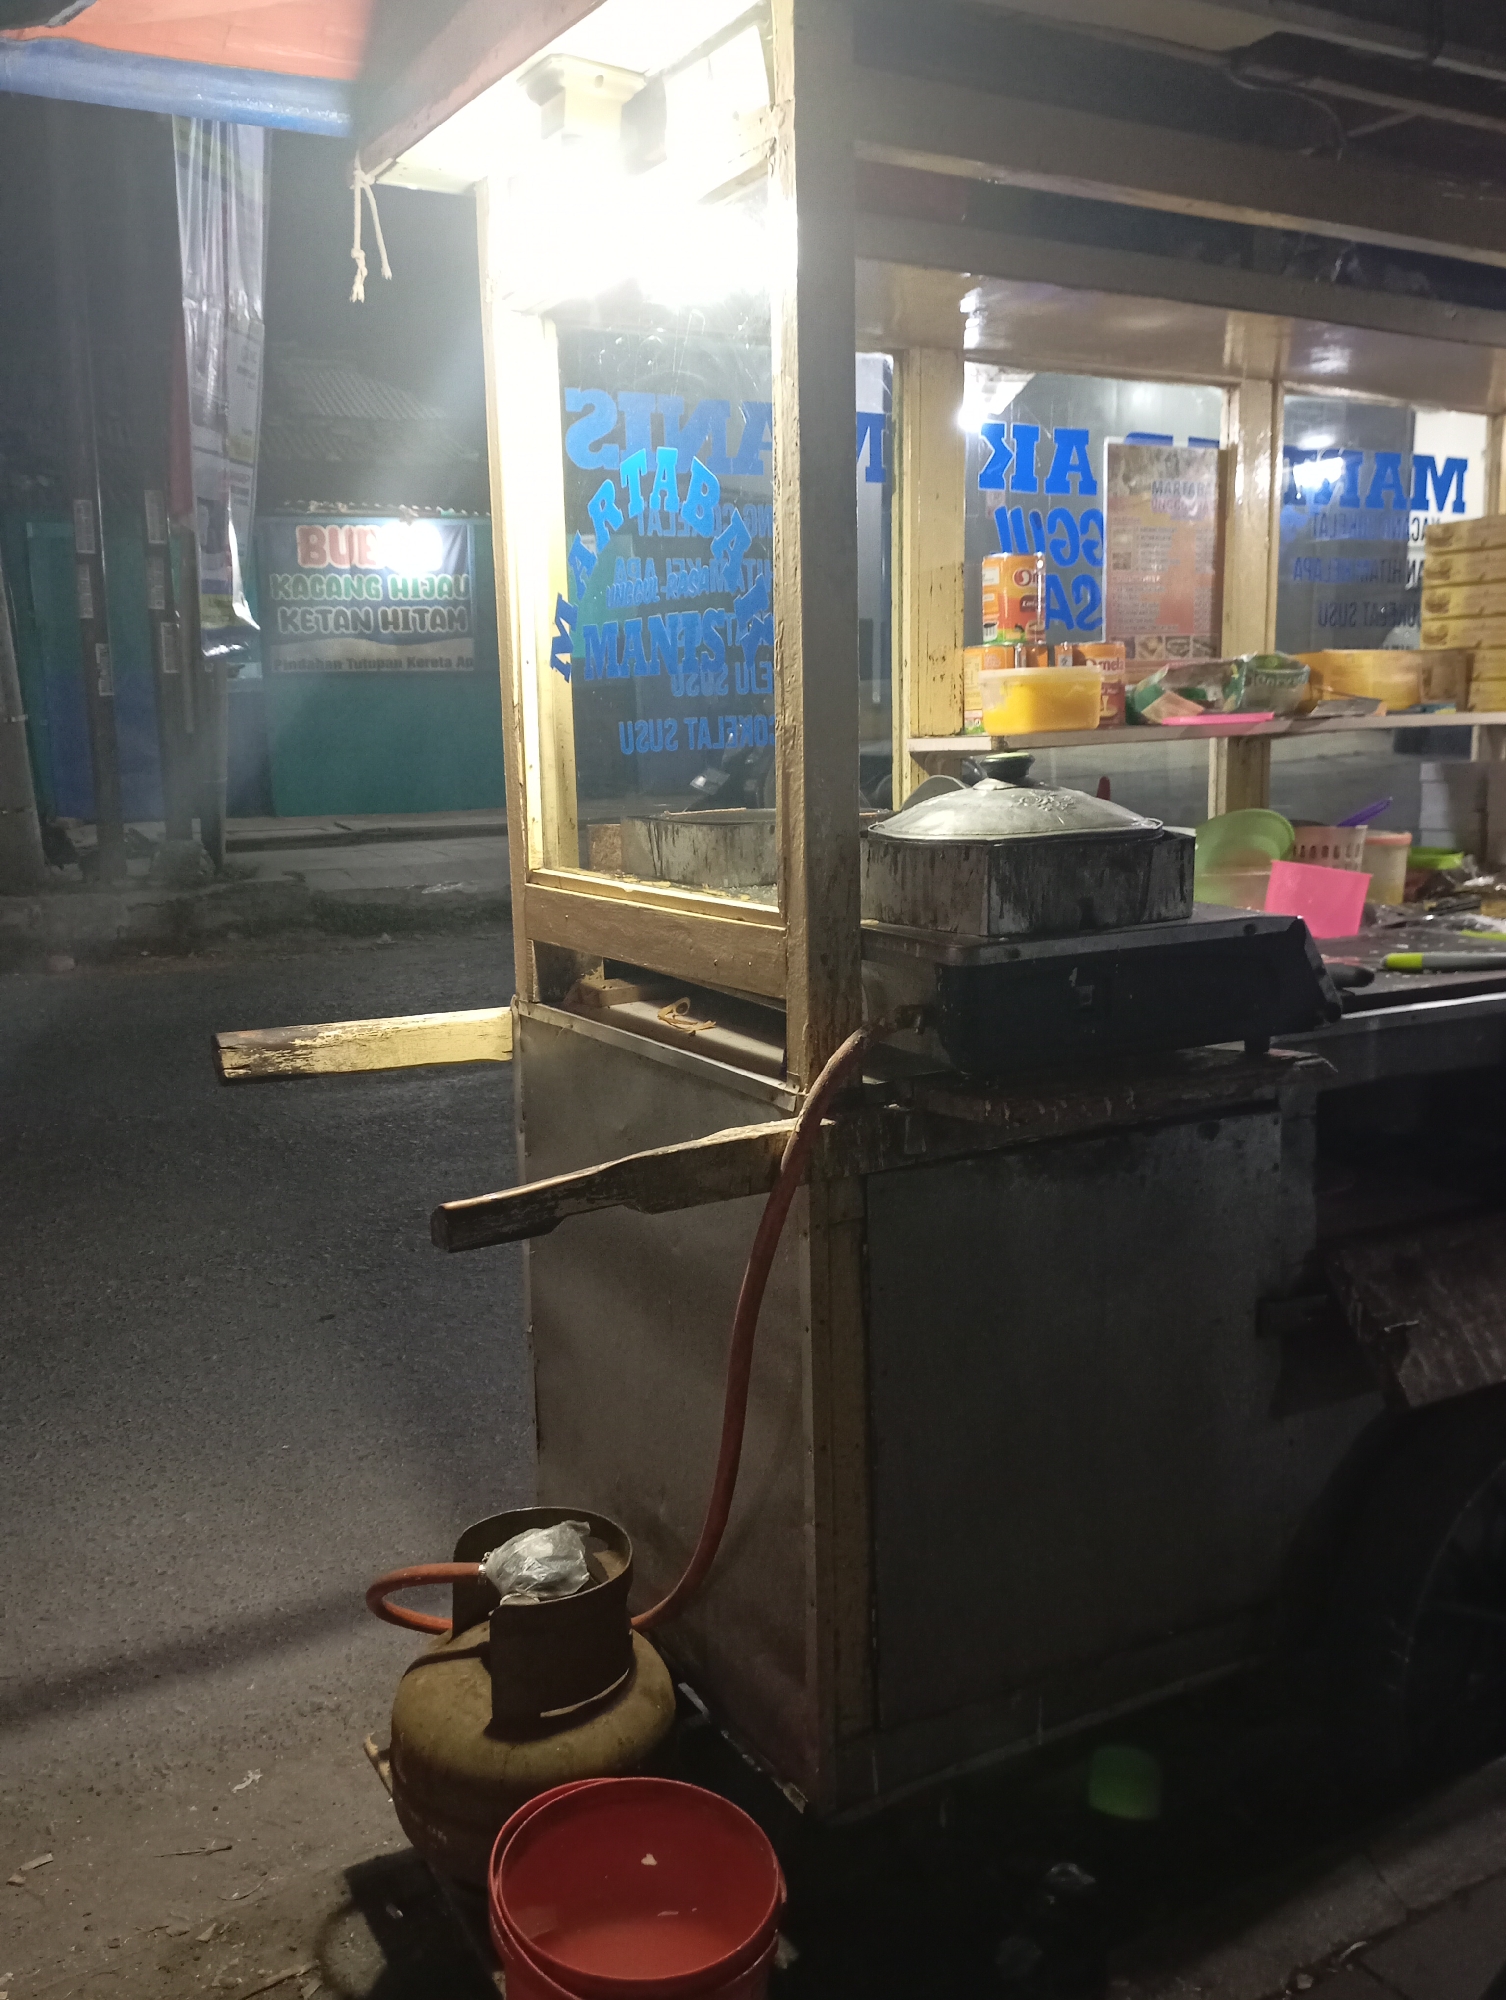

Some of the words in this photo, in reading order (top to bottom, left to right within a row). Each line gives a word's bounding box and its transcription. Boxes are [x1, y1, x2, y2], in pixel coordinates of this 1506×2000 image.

[387, 573, 470, 600] HIJAU
[278, 606, 374, 634] KETAN
[378, 606, 468, 634] HITAM
[582, 607, 727, 682] MANIS
